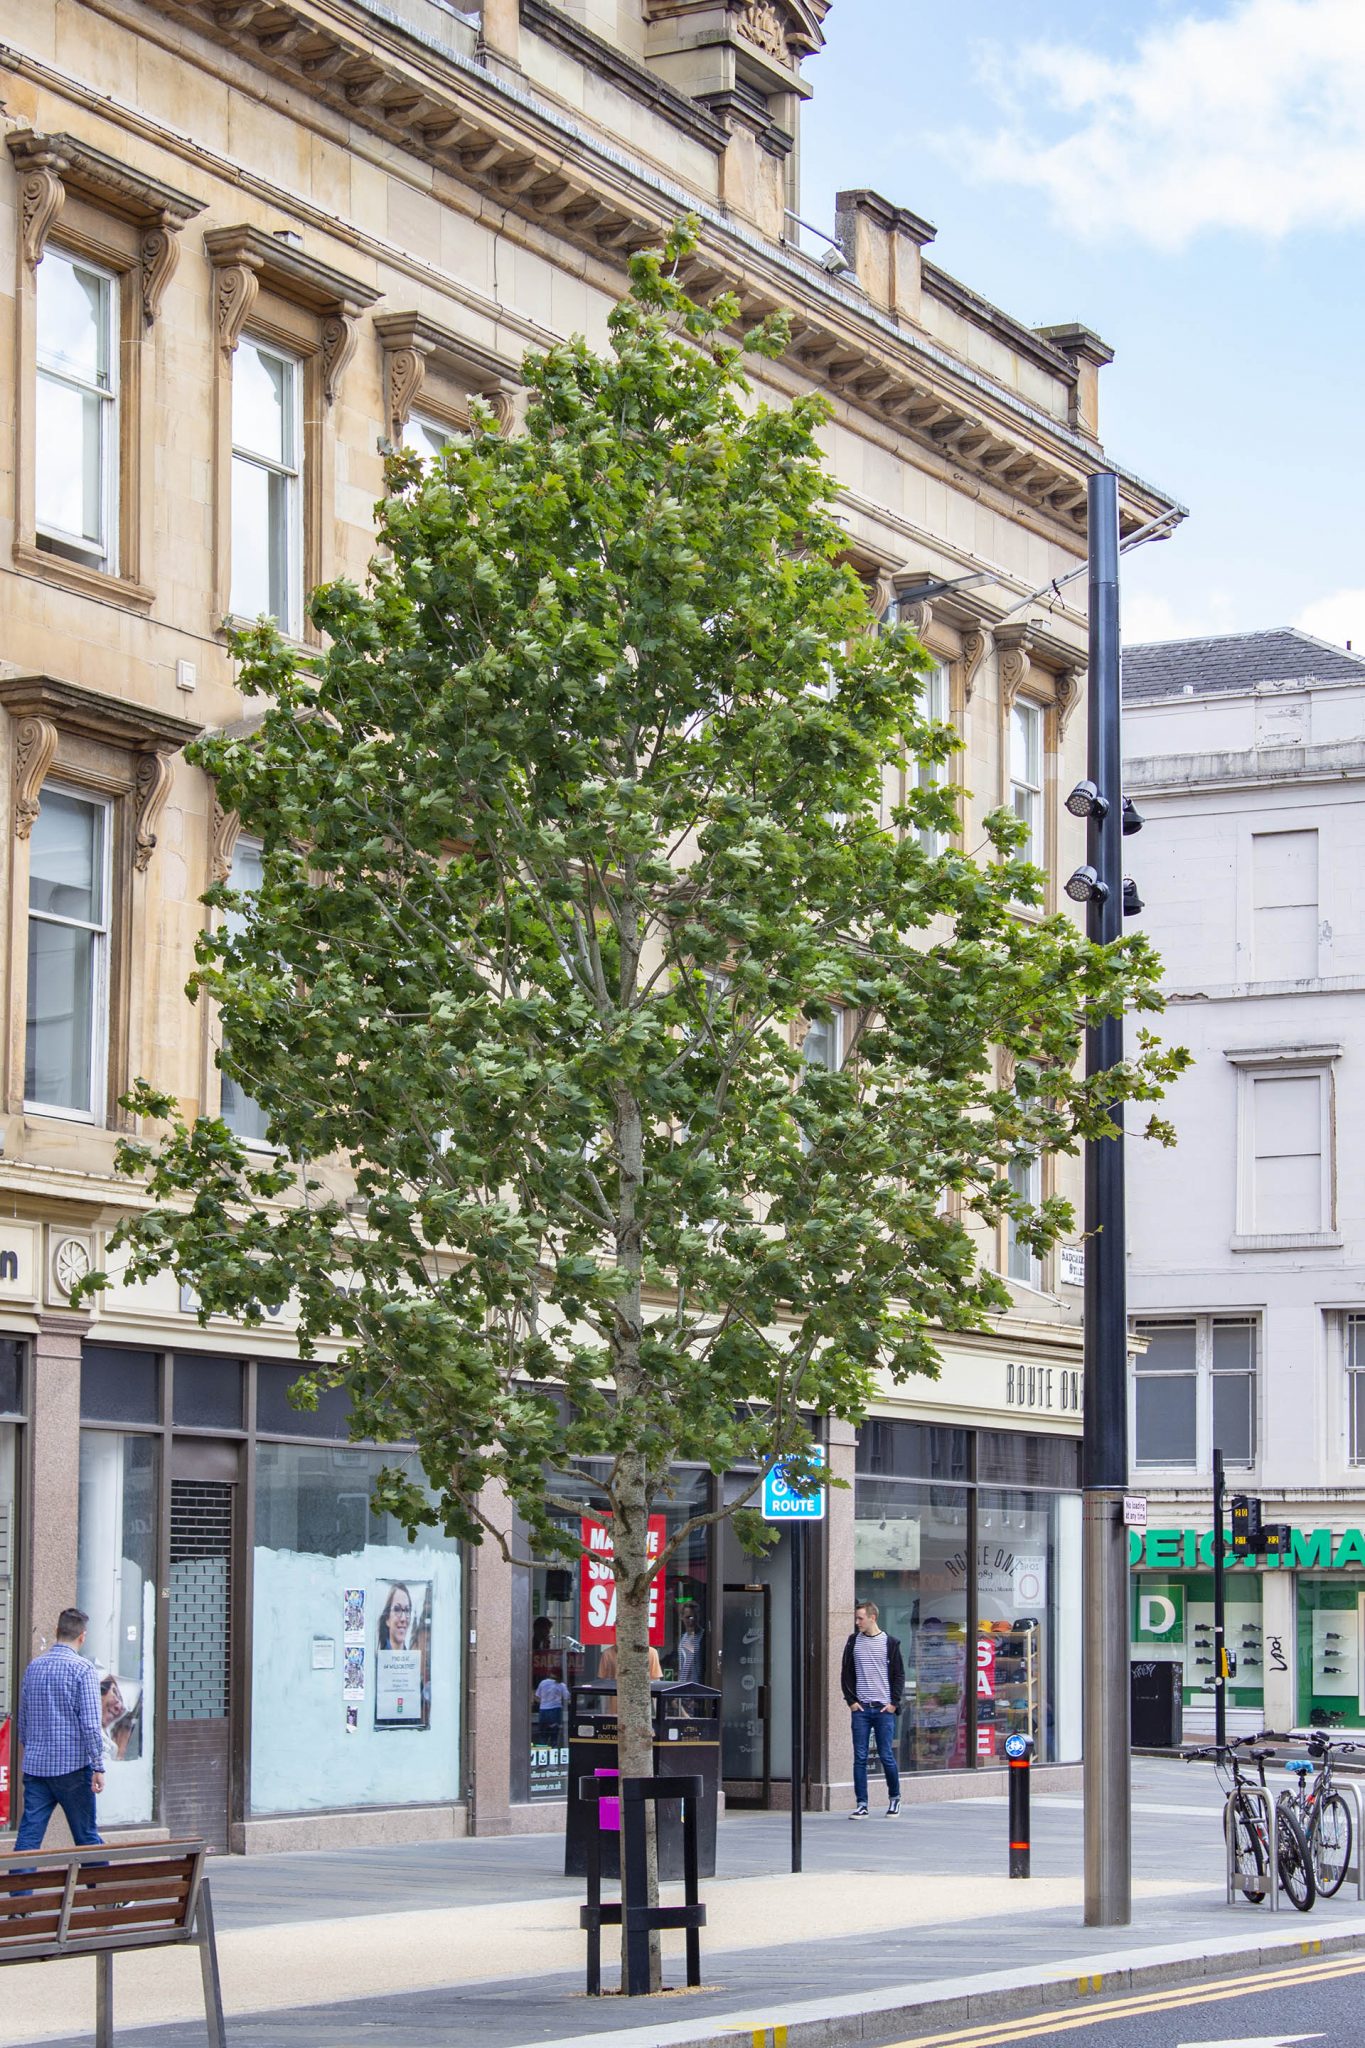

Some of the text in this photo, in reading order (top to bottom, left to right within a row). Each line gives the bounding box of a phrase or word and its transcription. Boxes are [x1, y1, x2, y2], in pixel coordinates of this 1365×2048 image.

[1007, 1363, 1053, 1408] ROUTE
[772, 1500, 815, 1511] ROUTE
[1139, 1595, 1176, 1634] D
